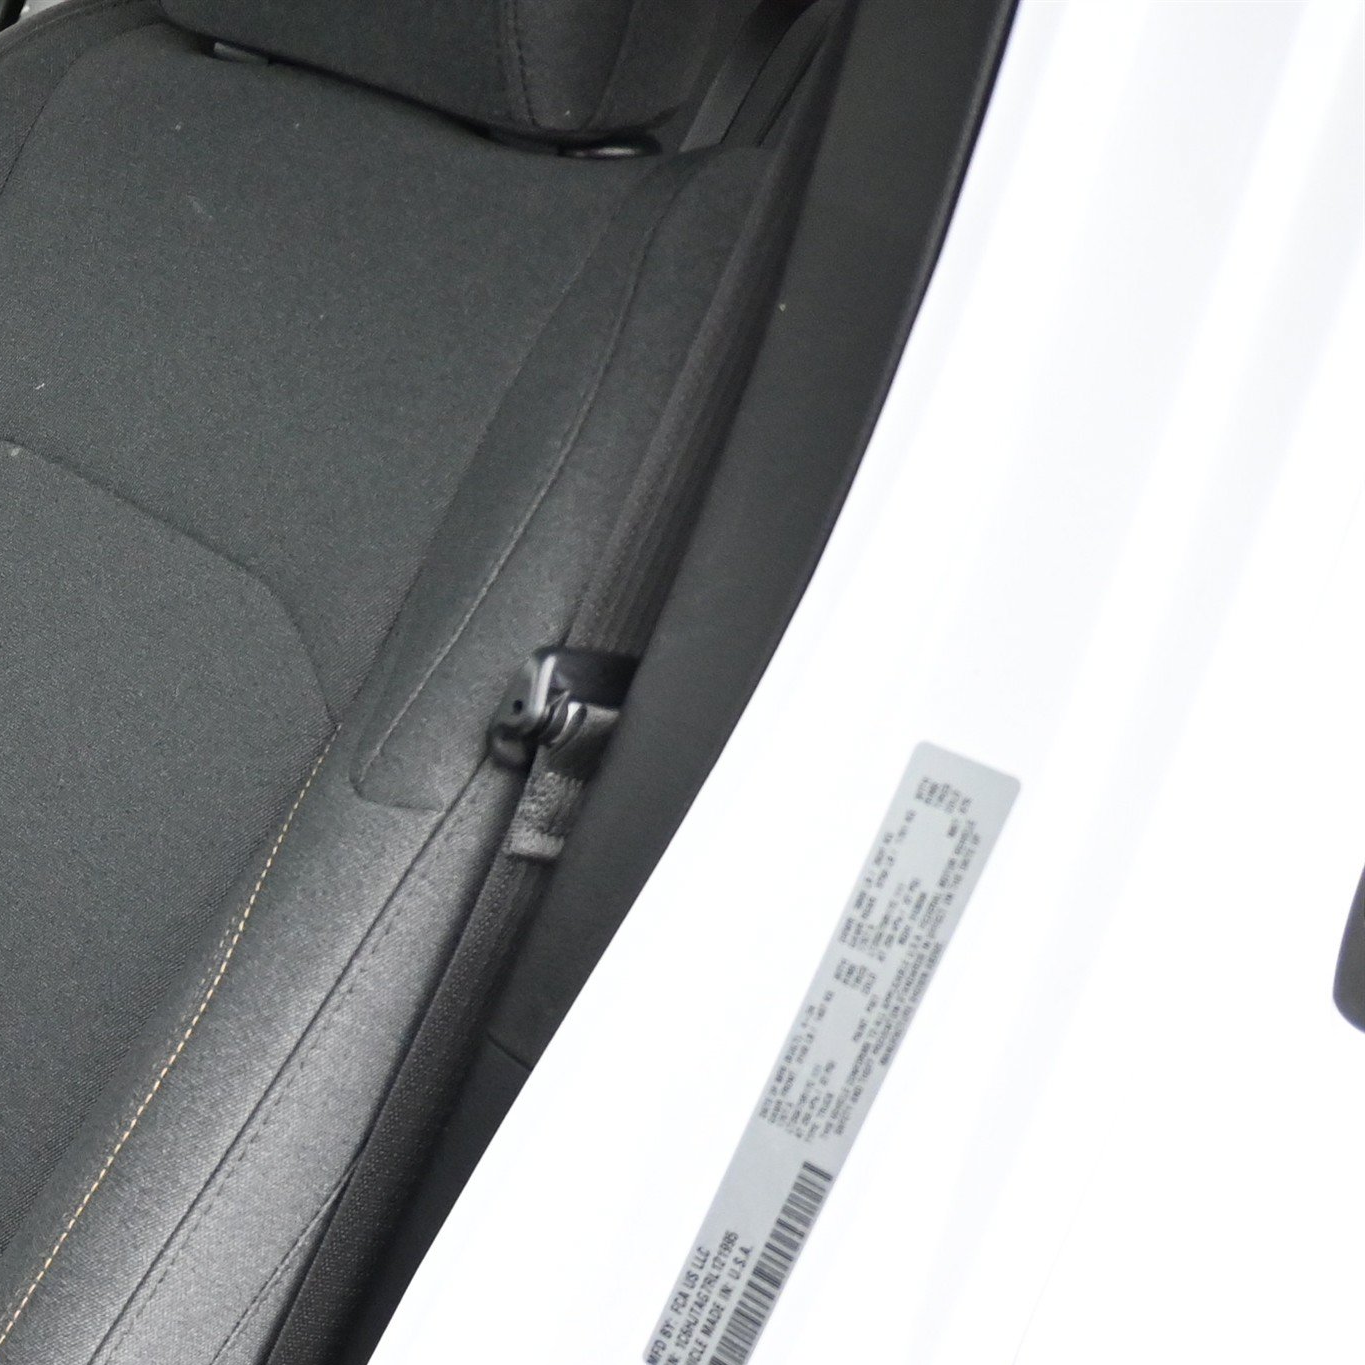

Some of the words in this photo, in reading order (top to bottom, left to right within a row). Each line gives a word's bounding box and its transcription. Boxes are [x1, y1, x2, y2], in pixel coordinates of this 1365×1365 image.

[647, 1339, 667, 1365] MFD
[671, 1291, 689, 1314] FCA
[682, 1270, 699, 1288] US
[691, 1246, 710, 1268] LLC
[700, 1302, 724, 1337] MADE
